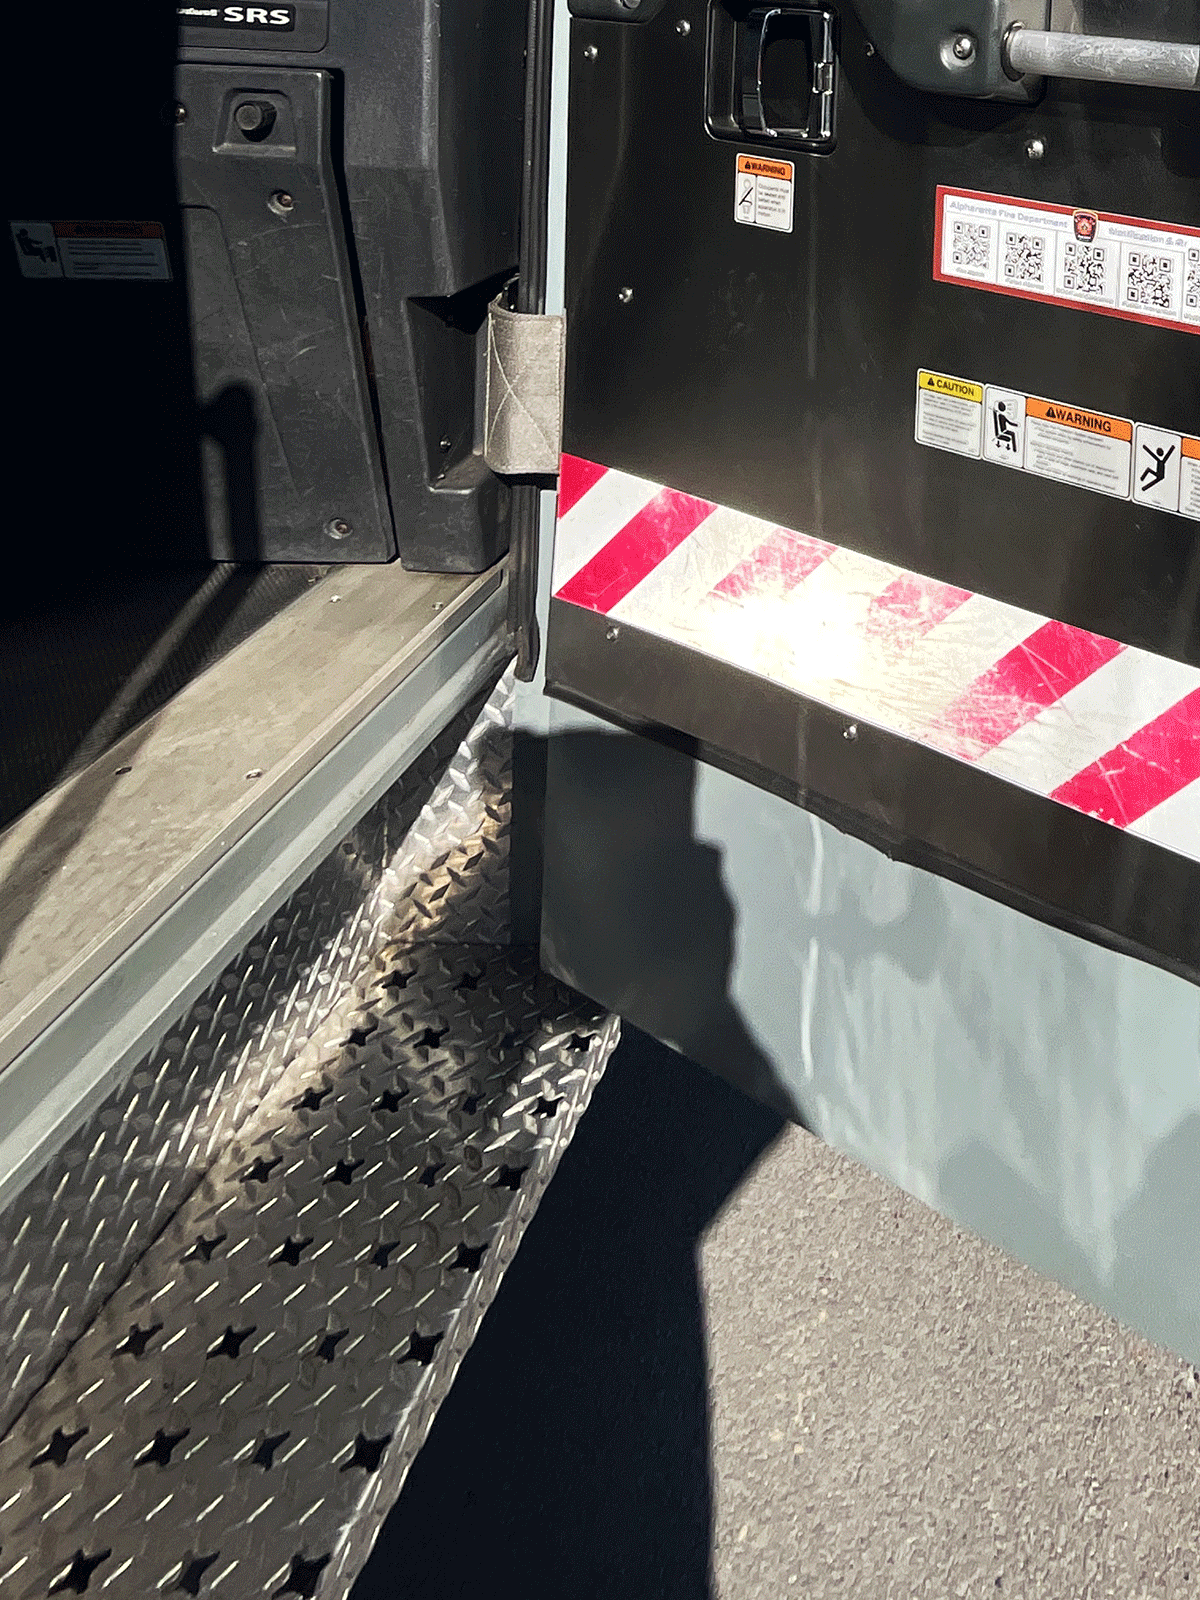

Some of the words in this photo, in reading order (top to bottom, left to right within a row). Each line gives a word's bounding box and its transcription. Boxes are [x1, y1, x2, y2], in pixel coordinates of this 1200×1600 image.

[224, 6, 290, 25] SRS
[752, 162, 785, 175] WARNING
[1018, 213, 1068, 228] Department
[937, 379, 974, 396] CAUTION
[1055, 408, 1111, 432] WARNING
